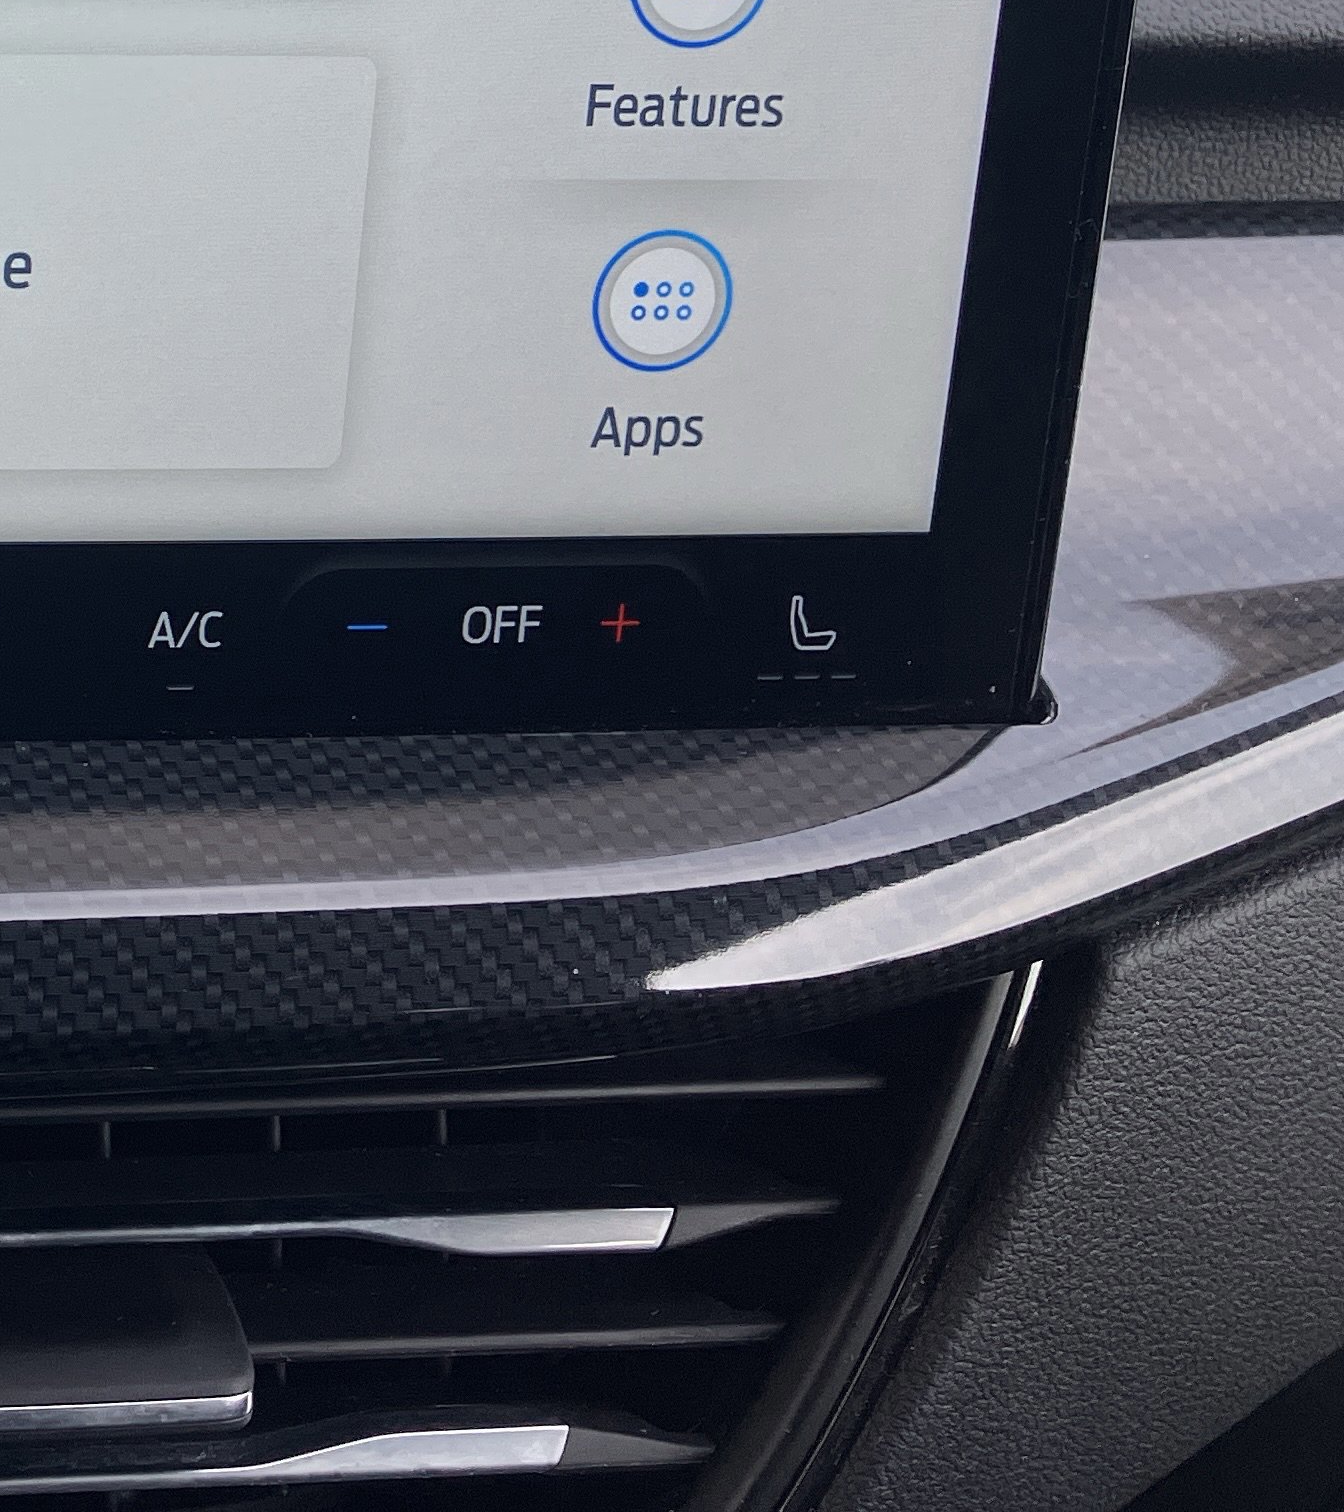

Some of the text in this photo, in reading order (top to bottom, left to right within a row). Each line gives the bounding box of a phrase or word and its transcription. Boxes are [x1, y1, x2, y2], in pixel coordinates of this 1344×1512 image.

[585, 83, 784, 128] Features
[590, 406, 704, 457] Apps
[147, 610, 224, 649] A/C
[462, 605, 544, 644] OFF
